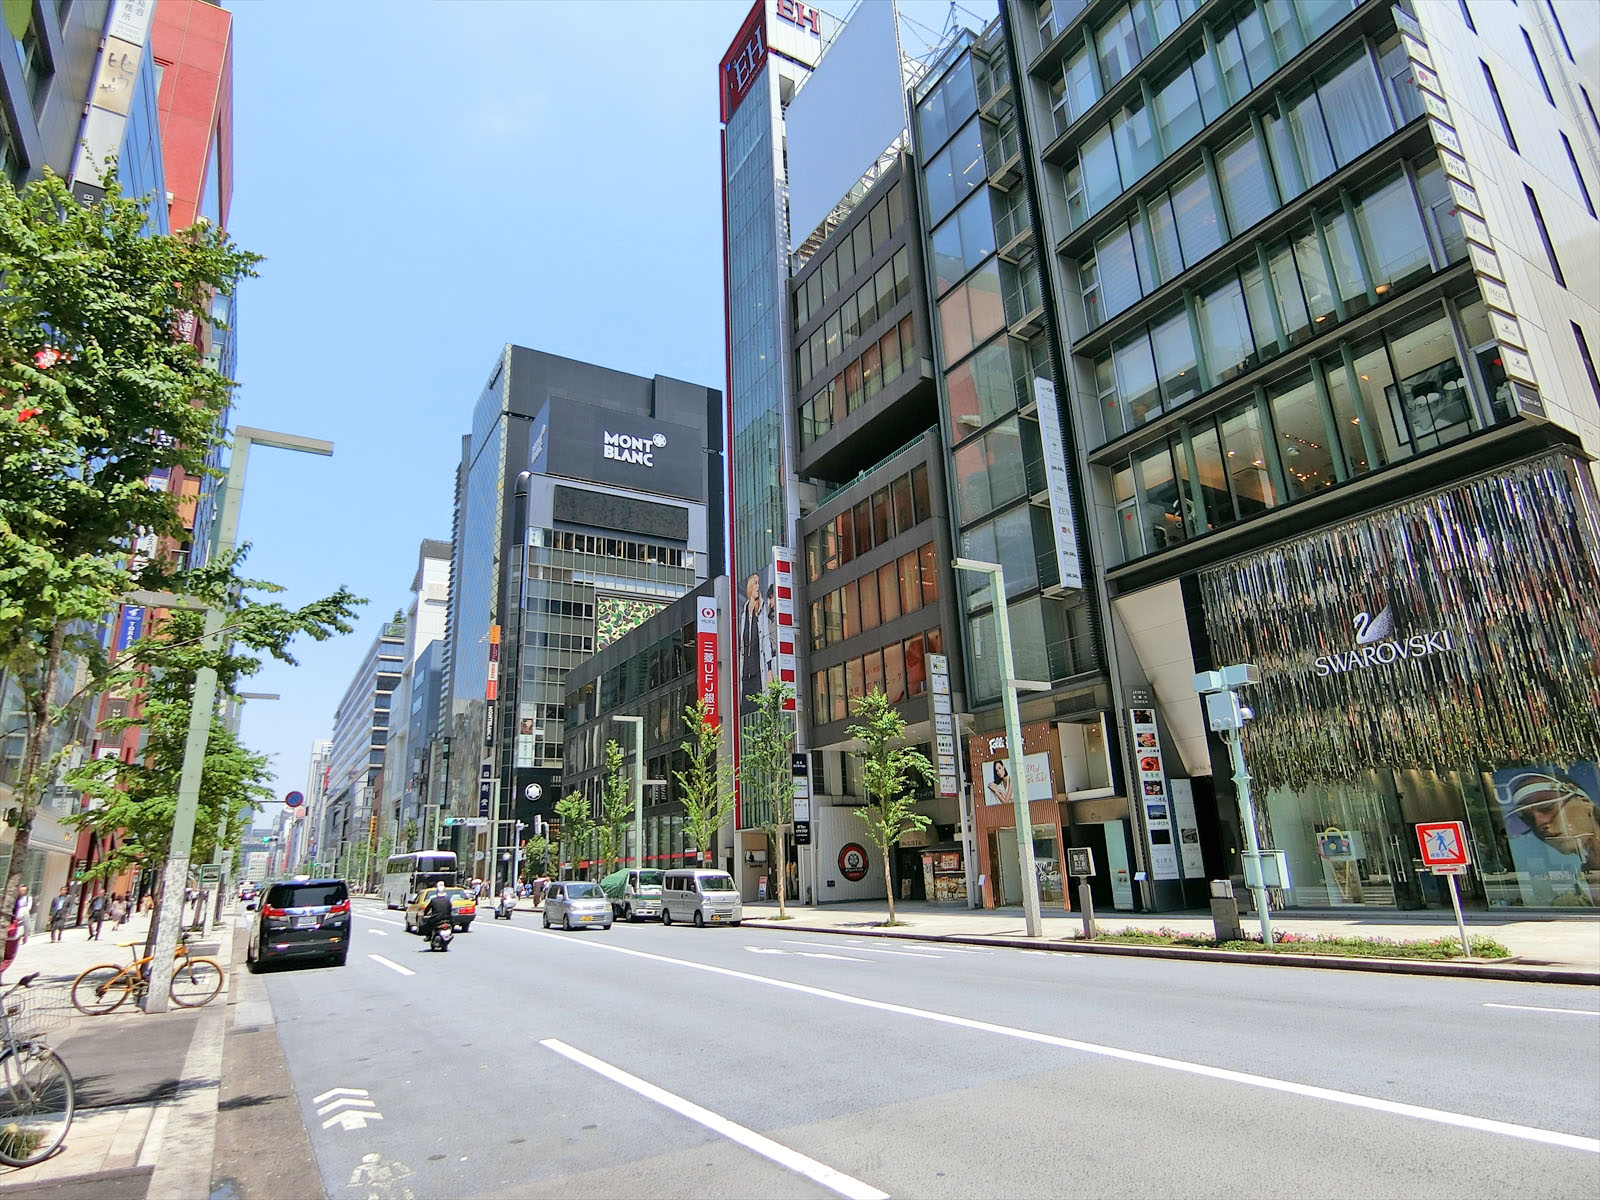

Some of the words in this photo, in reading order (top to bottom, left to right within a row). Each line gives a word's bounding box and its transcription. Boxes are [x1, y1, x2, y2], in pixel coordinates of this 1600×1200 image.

[776, 0, 820, 35] EH
[603, 444, 654, 467] BLANC
[604, 430, 653, 453] MONT
[1314, 629, 1455, 677] SWAROVSKI
[703, 641, 715, 715] 三菱UFJ銀行
